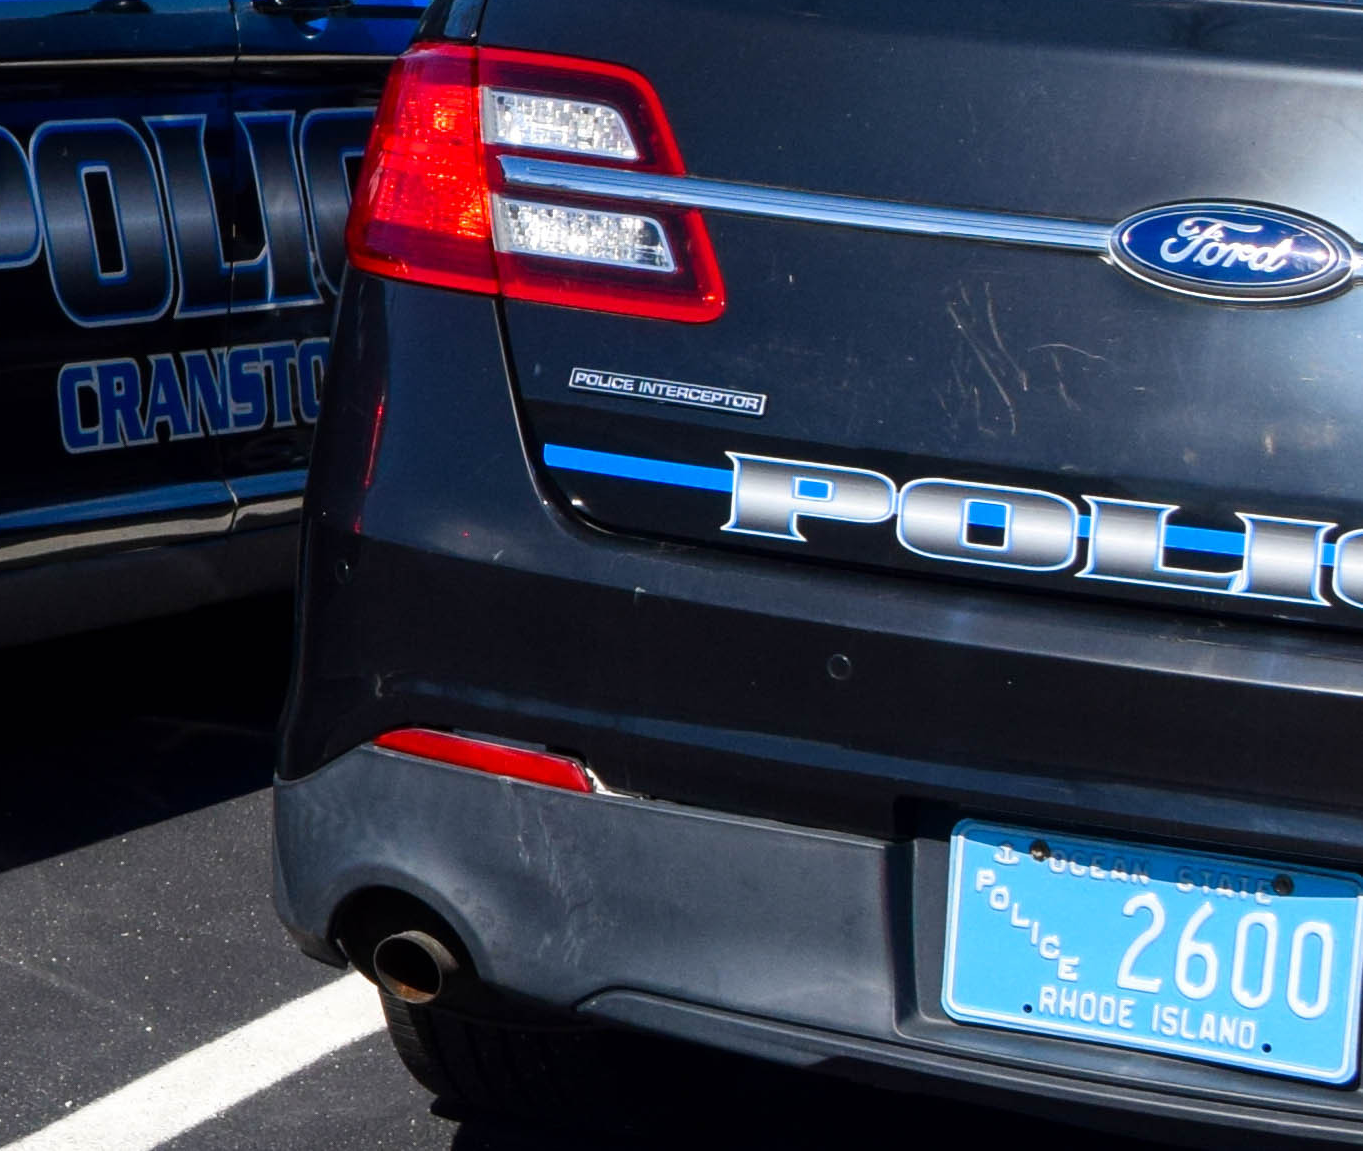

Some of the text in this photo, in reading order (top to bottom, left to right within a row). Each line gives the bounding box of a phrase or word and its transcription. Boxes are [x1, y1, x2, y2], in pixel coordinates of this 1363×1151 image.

[1160, 216, 1293, 273] Ford
[56, 336, 331, 454] CRANSTO
[574, 371, 759, 410] POLICE INTERCEPTOR
[720, 451, 1363, 608] POLI
[1047, 850, 1274, 905] OCEAN STATE
[975, 868, 1080, 982] POLICE
[1116, 891, 1333, 1019] 2600
[1037, 986, 1257, 1050] RHODE ISLAND
